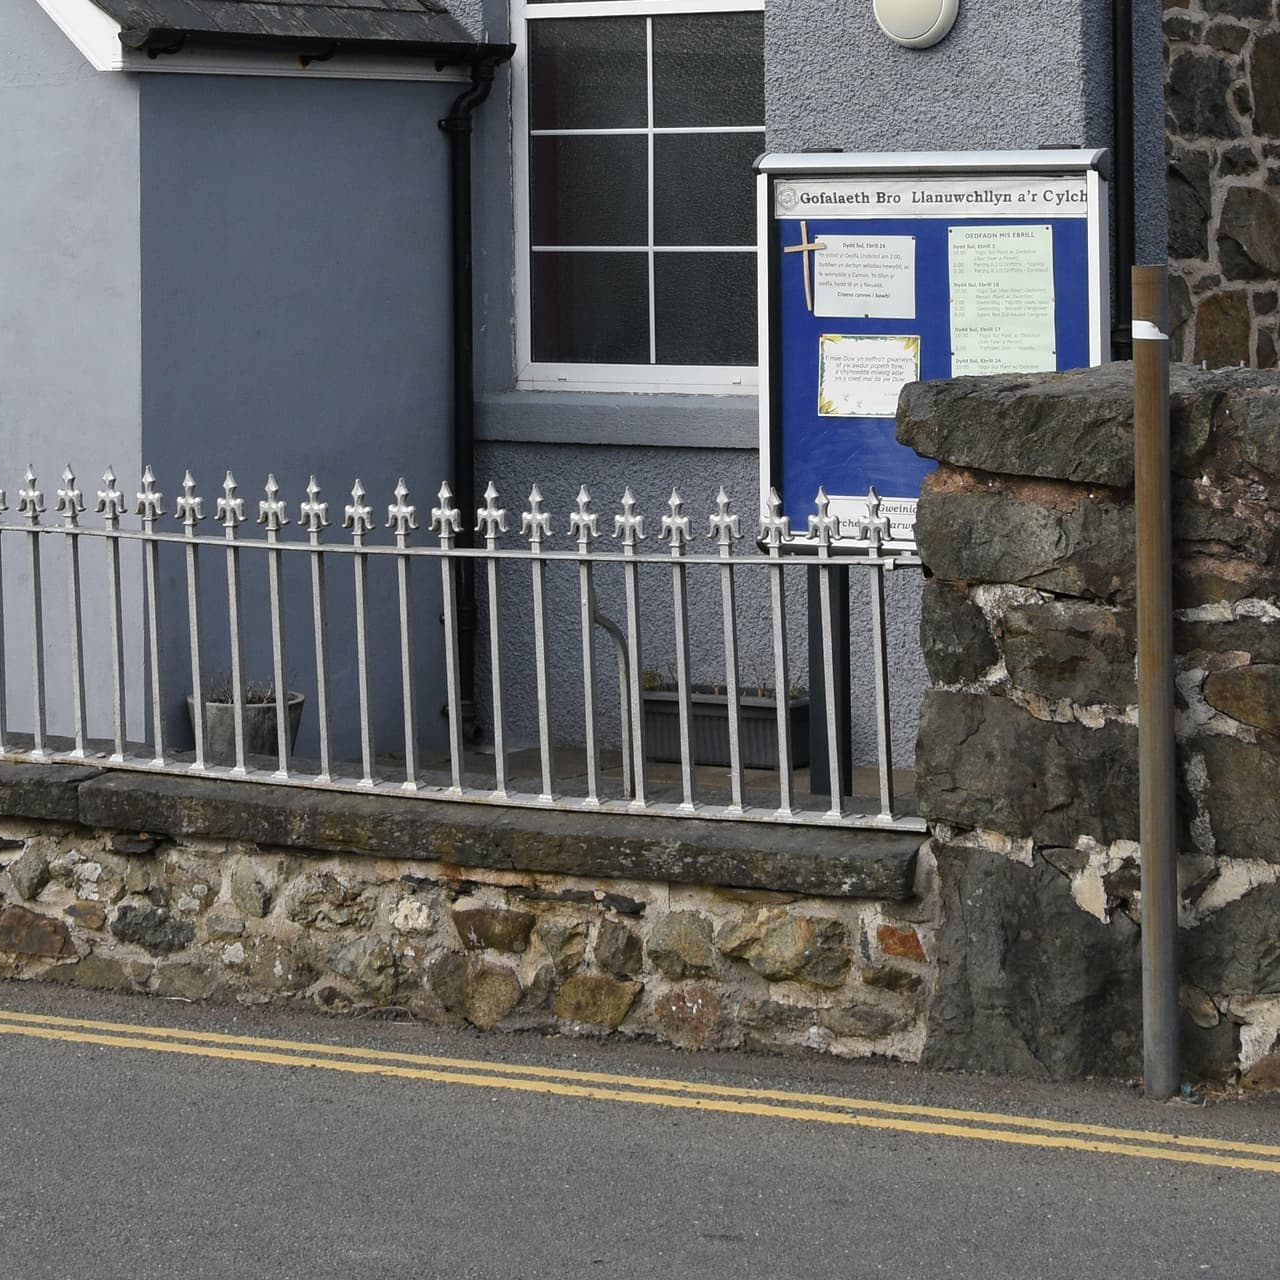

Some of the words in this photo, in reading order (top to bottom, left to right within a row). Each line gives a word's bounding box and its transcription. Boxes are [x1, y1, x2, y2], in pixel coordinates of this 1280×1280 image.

[800, 192, 870, 204] Gofalaeth
[876, 192, 902, 204] Bro
[911, 191, 1012, 206] Llanuwchllyn
[1043, 189, 1088, 206] Cylch
